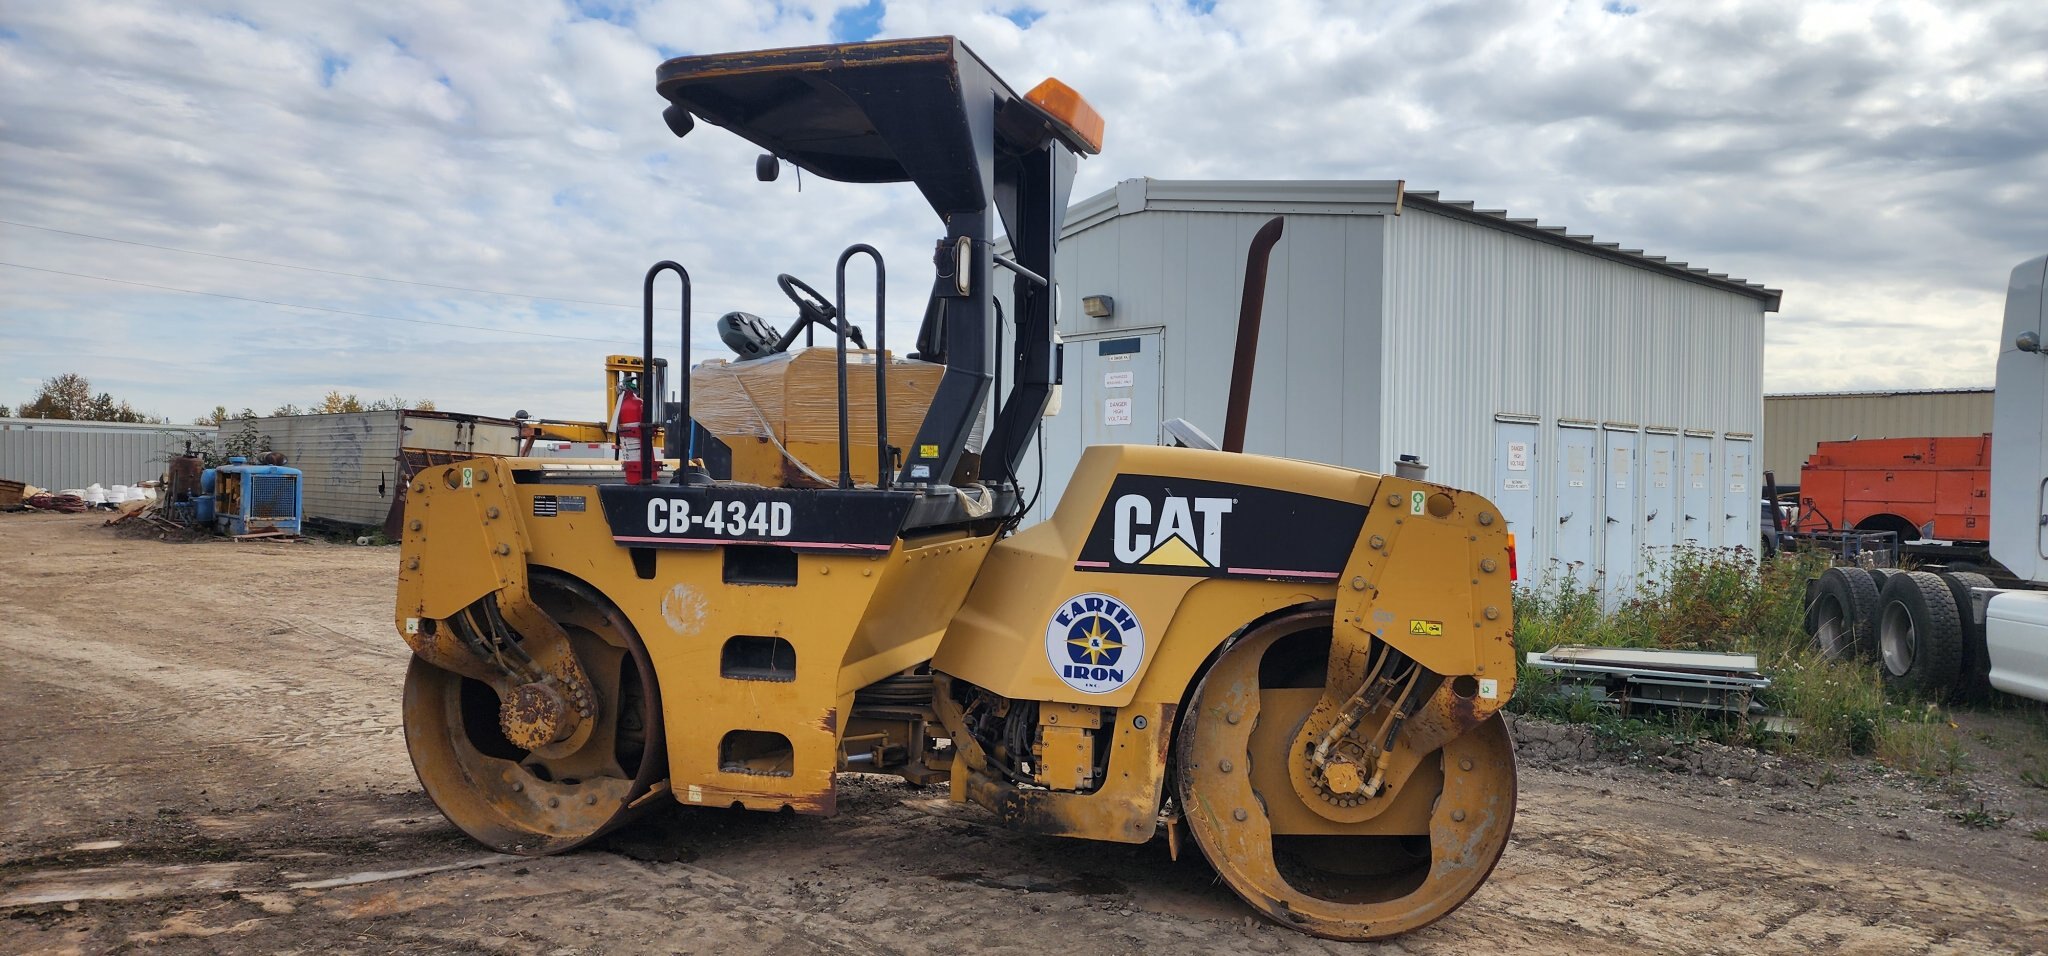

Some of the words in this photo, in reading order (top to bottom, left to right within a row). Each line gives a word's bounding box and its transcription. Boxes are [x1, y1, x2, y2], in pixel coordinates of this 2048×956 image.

[647, 497, 792, 537] CB-434D
[1113, 494, 1233, 568] CAT
[1055, 597, 1137, 632] EARTH
[1091, 638, 1100, 647] &
[1063, 664, 1124, 683] IRON
